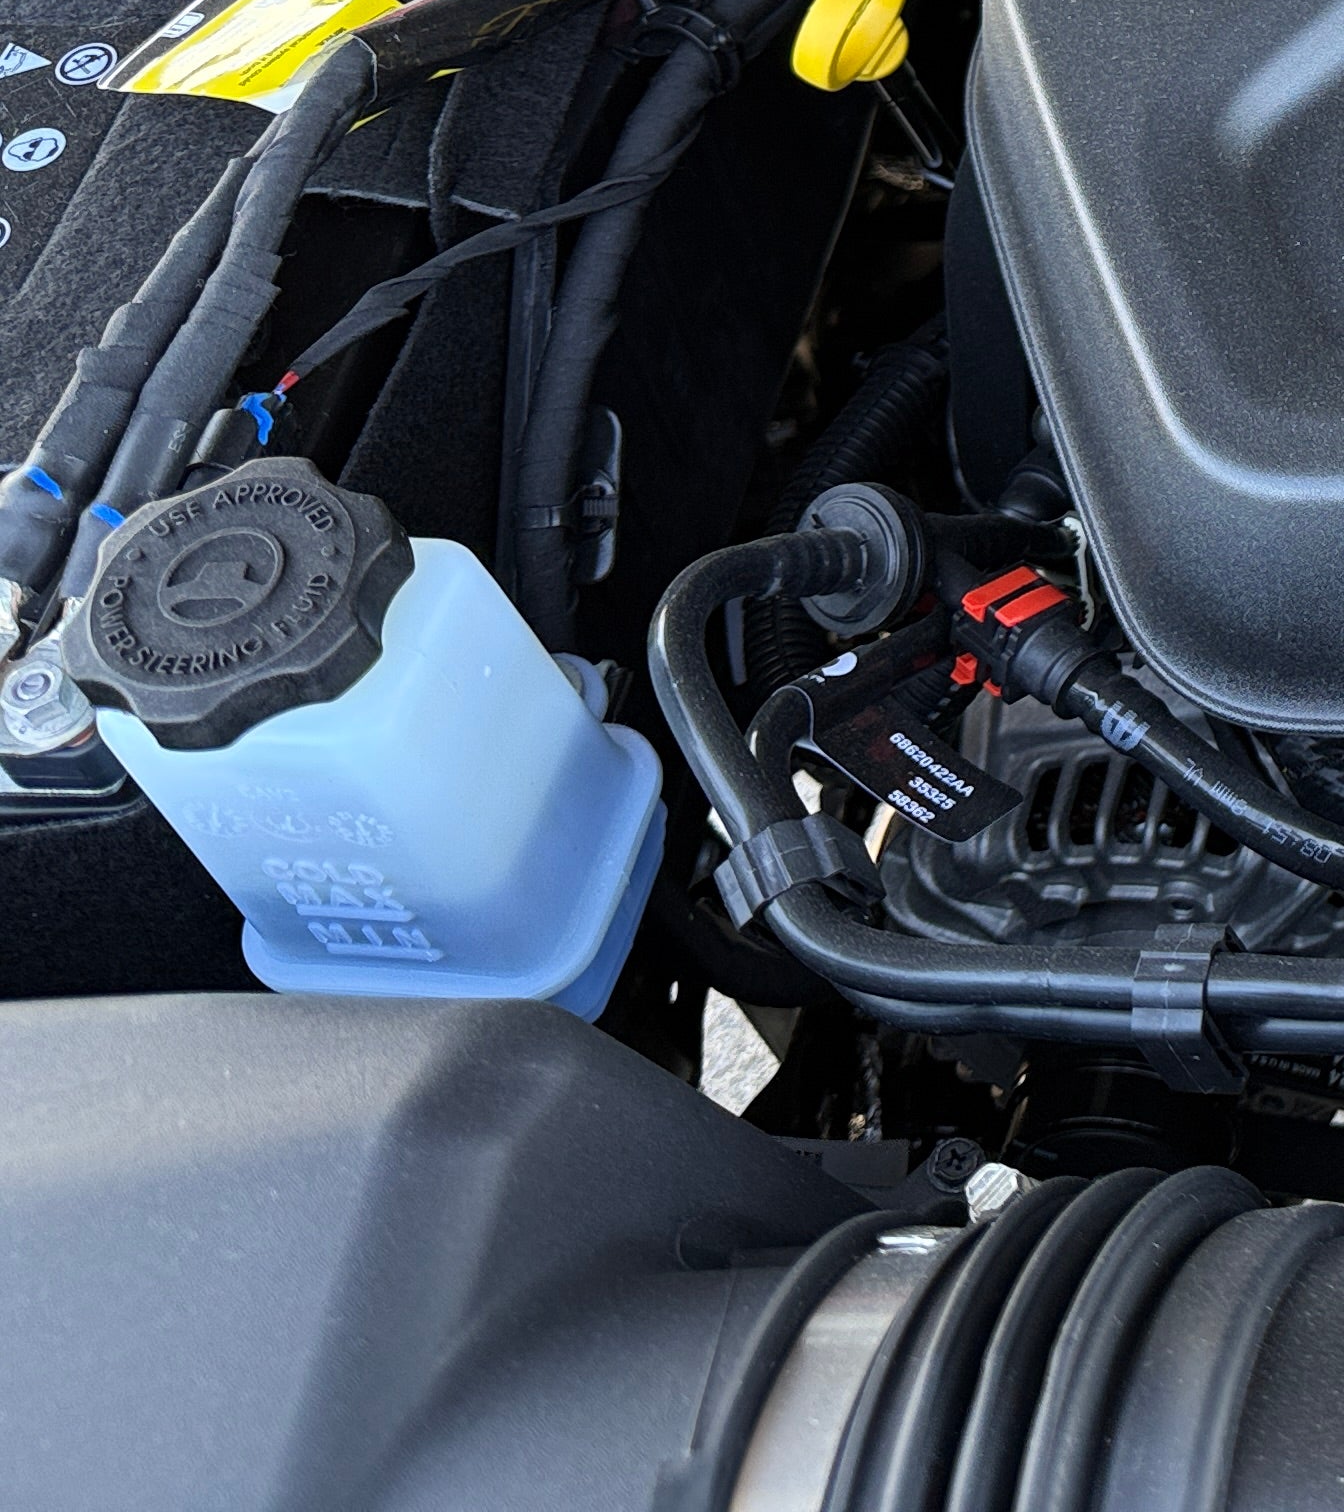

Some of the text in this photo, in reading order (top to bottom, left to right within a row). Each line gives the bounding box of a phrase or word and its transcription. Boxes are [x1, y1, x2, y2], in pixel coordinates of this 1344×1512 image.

[148, 482, 336, 539] USE APPROVED
[99, 571, 330, 676] POWER STEERING FLUID
[261, 855, 386, 888] COLD
[276, 880, 405, 913] MAX
[307, 920, 432, 950] MIN
